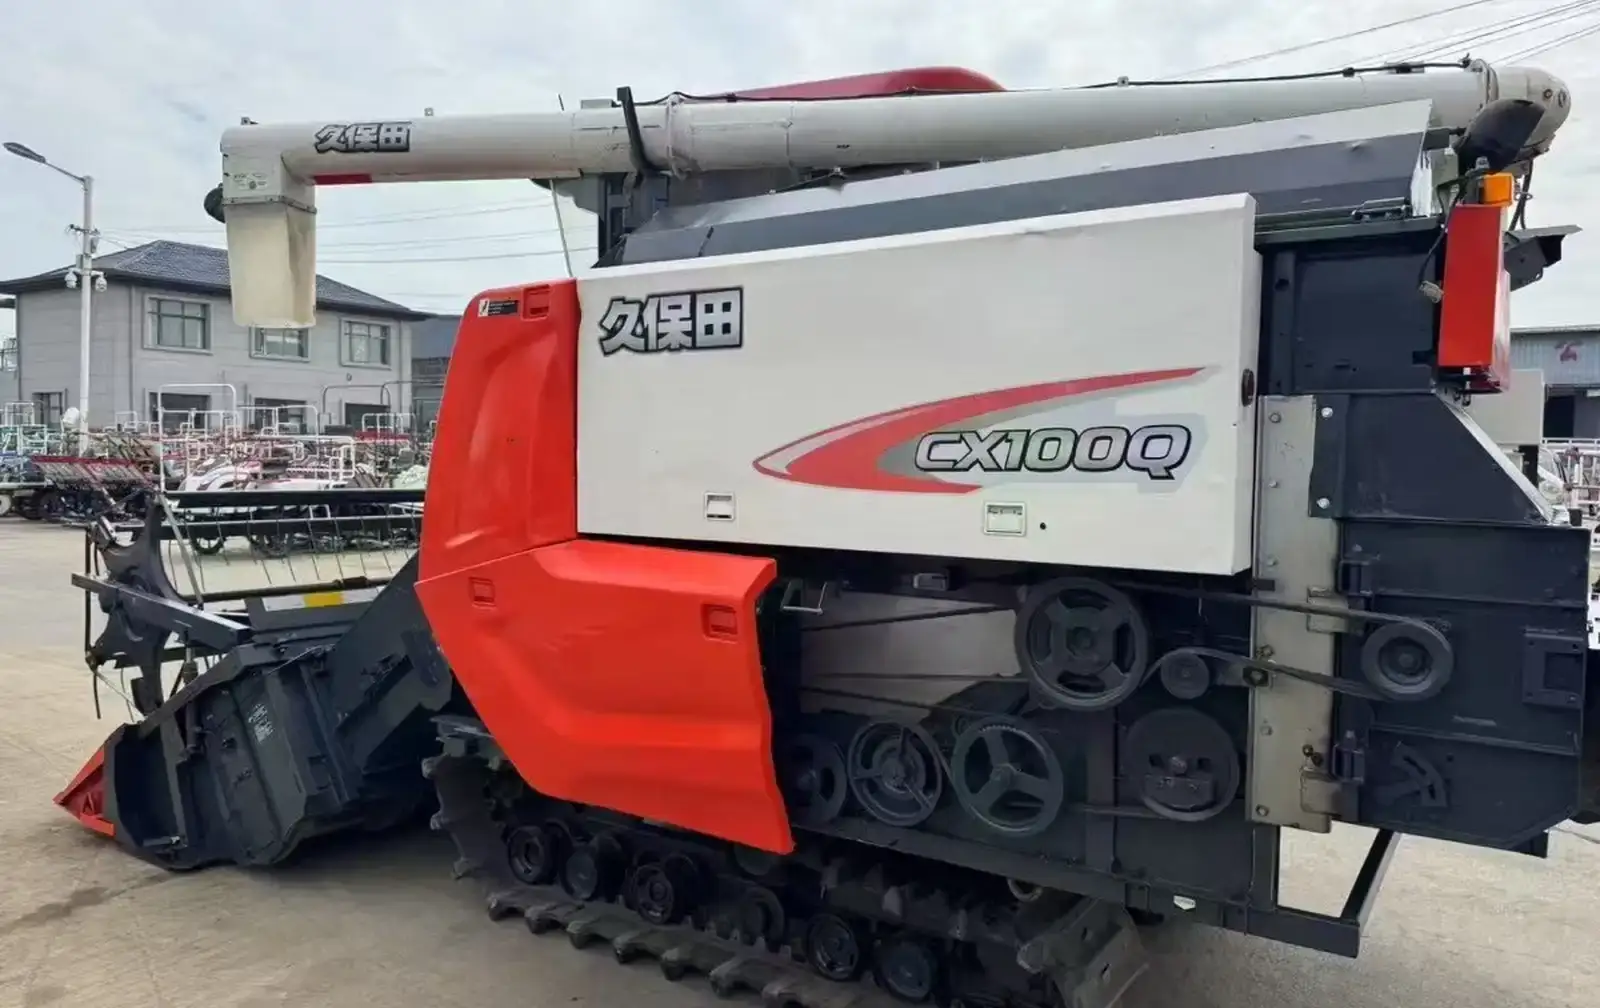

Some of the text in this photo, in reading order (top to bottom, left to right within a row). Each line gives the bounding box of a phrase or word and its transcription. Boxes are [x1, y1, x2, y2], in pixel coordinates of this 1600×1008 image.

[314, 121, 412, 154] 久保田
[598, 286, 743, 357] 久保田
[914, 424, 1192, 480] CX100Q
